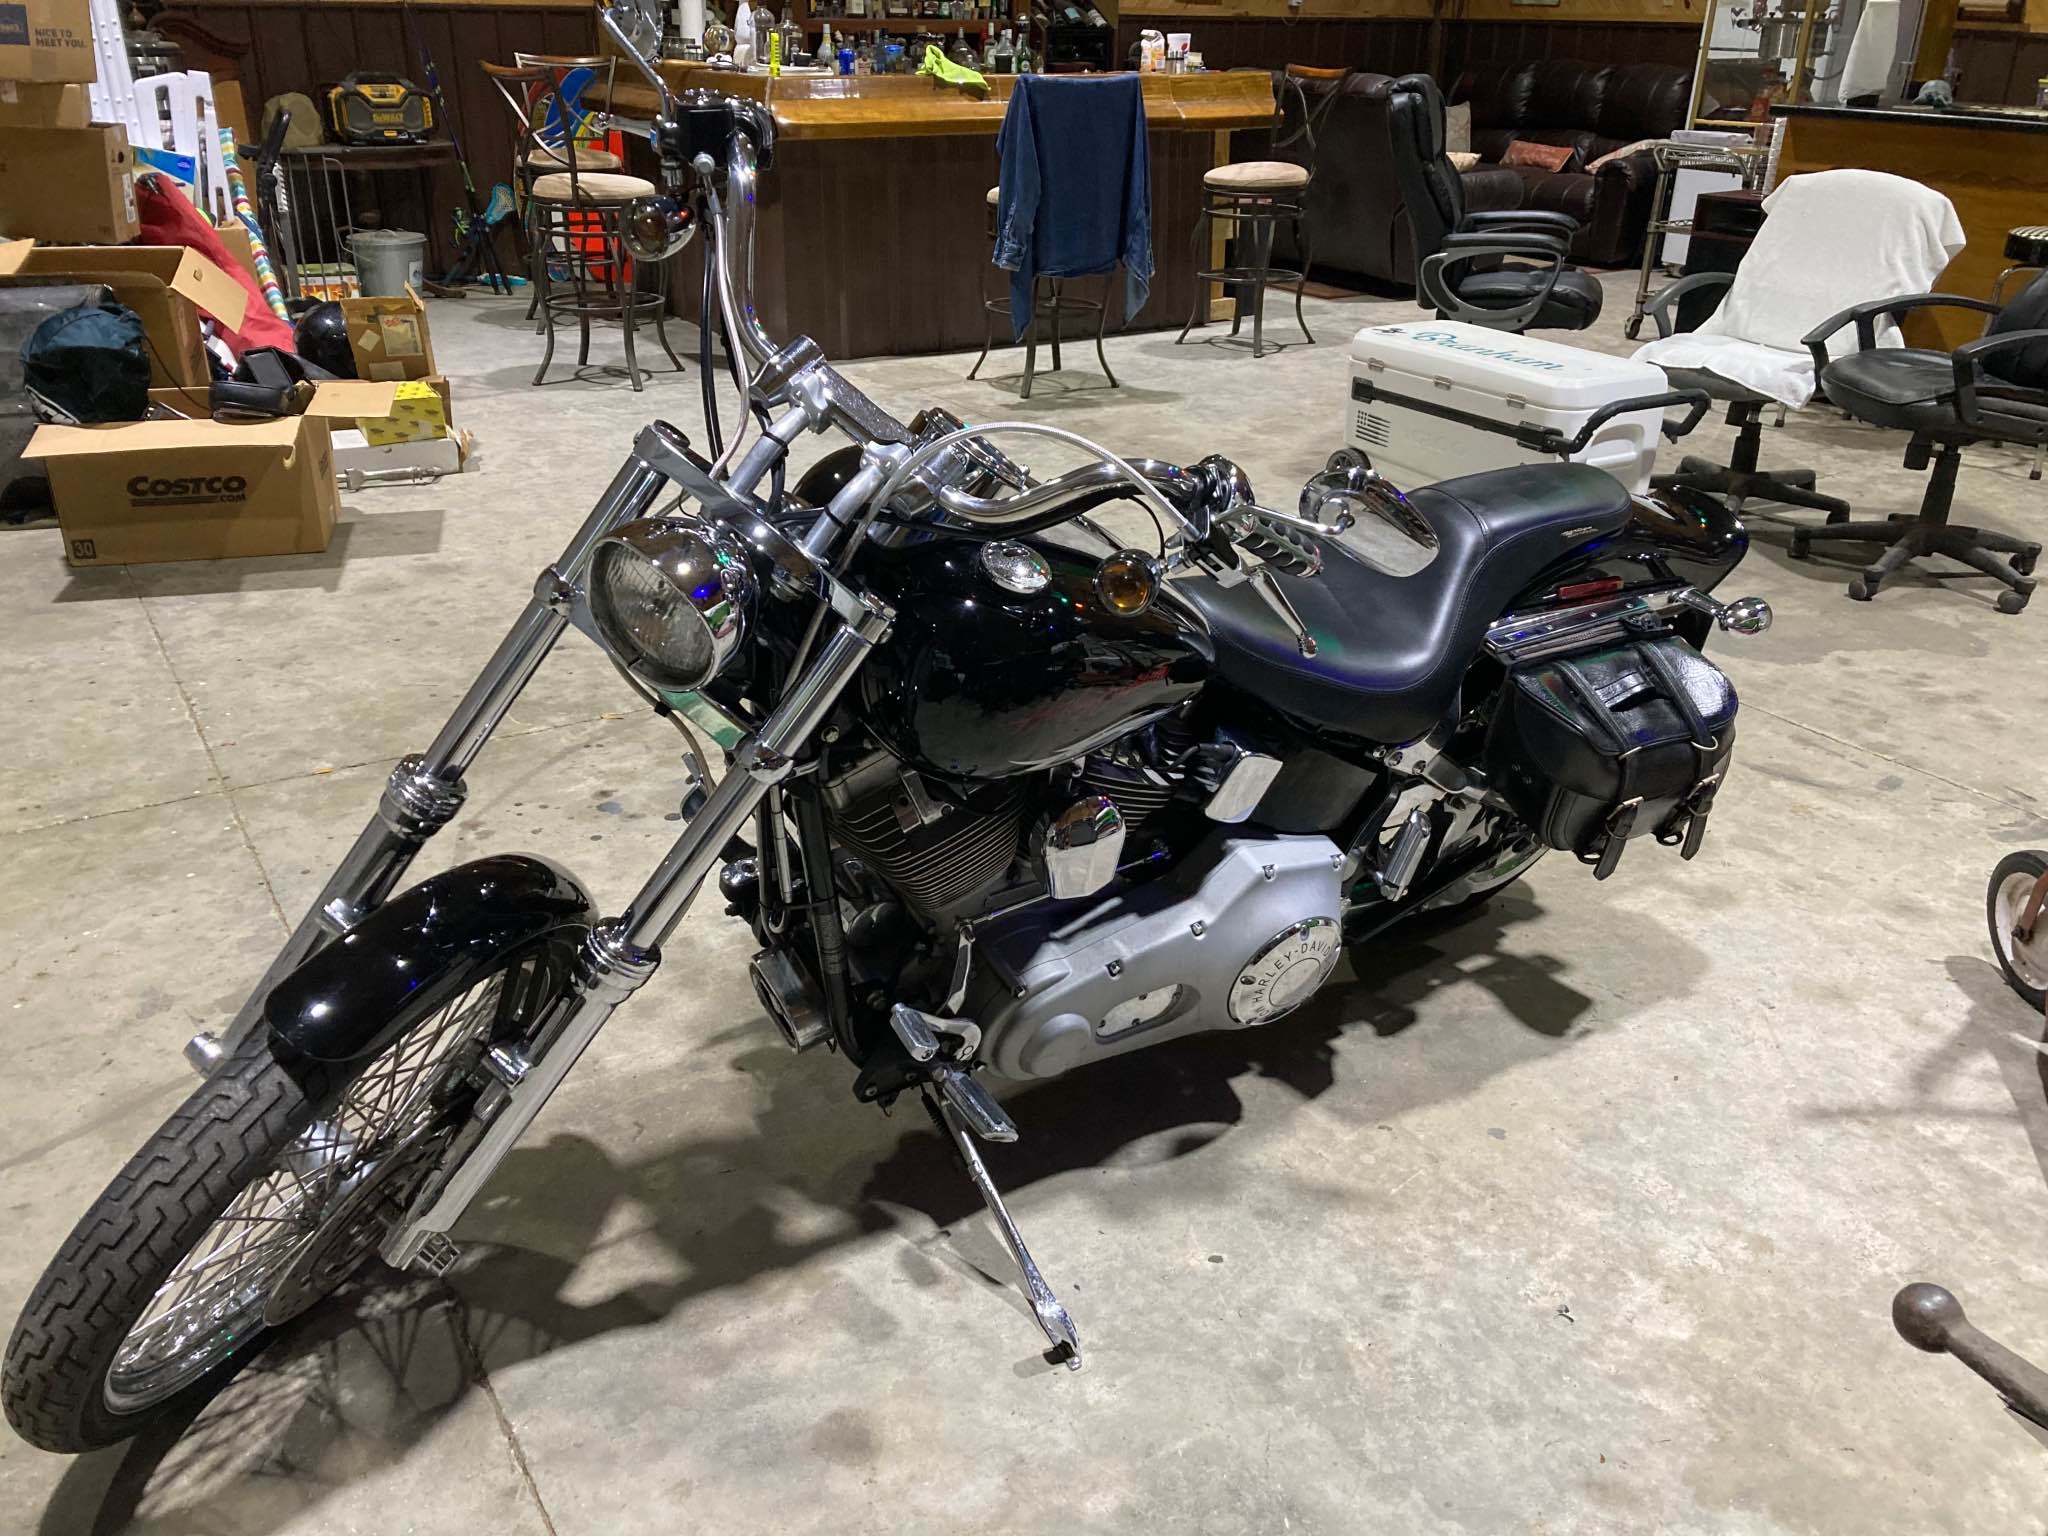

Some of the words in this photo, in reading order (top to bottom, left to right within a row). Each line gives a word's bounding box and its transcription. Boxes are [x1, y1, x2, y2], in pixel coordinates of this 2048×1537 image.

[35, 28, 58, 37] NICE
[60, 29, 72, 38] TO
[36, 38, 62, 47] MEET
[1411, 331, 1564, 370] Branham
[127, 475, 247, 496] COSTCO
[74, 540, 93, 557] 30
[1252, 940, 1332, 1004] HARLEY-DAVID
